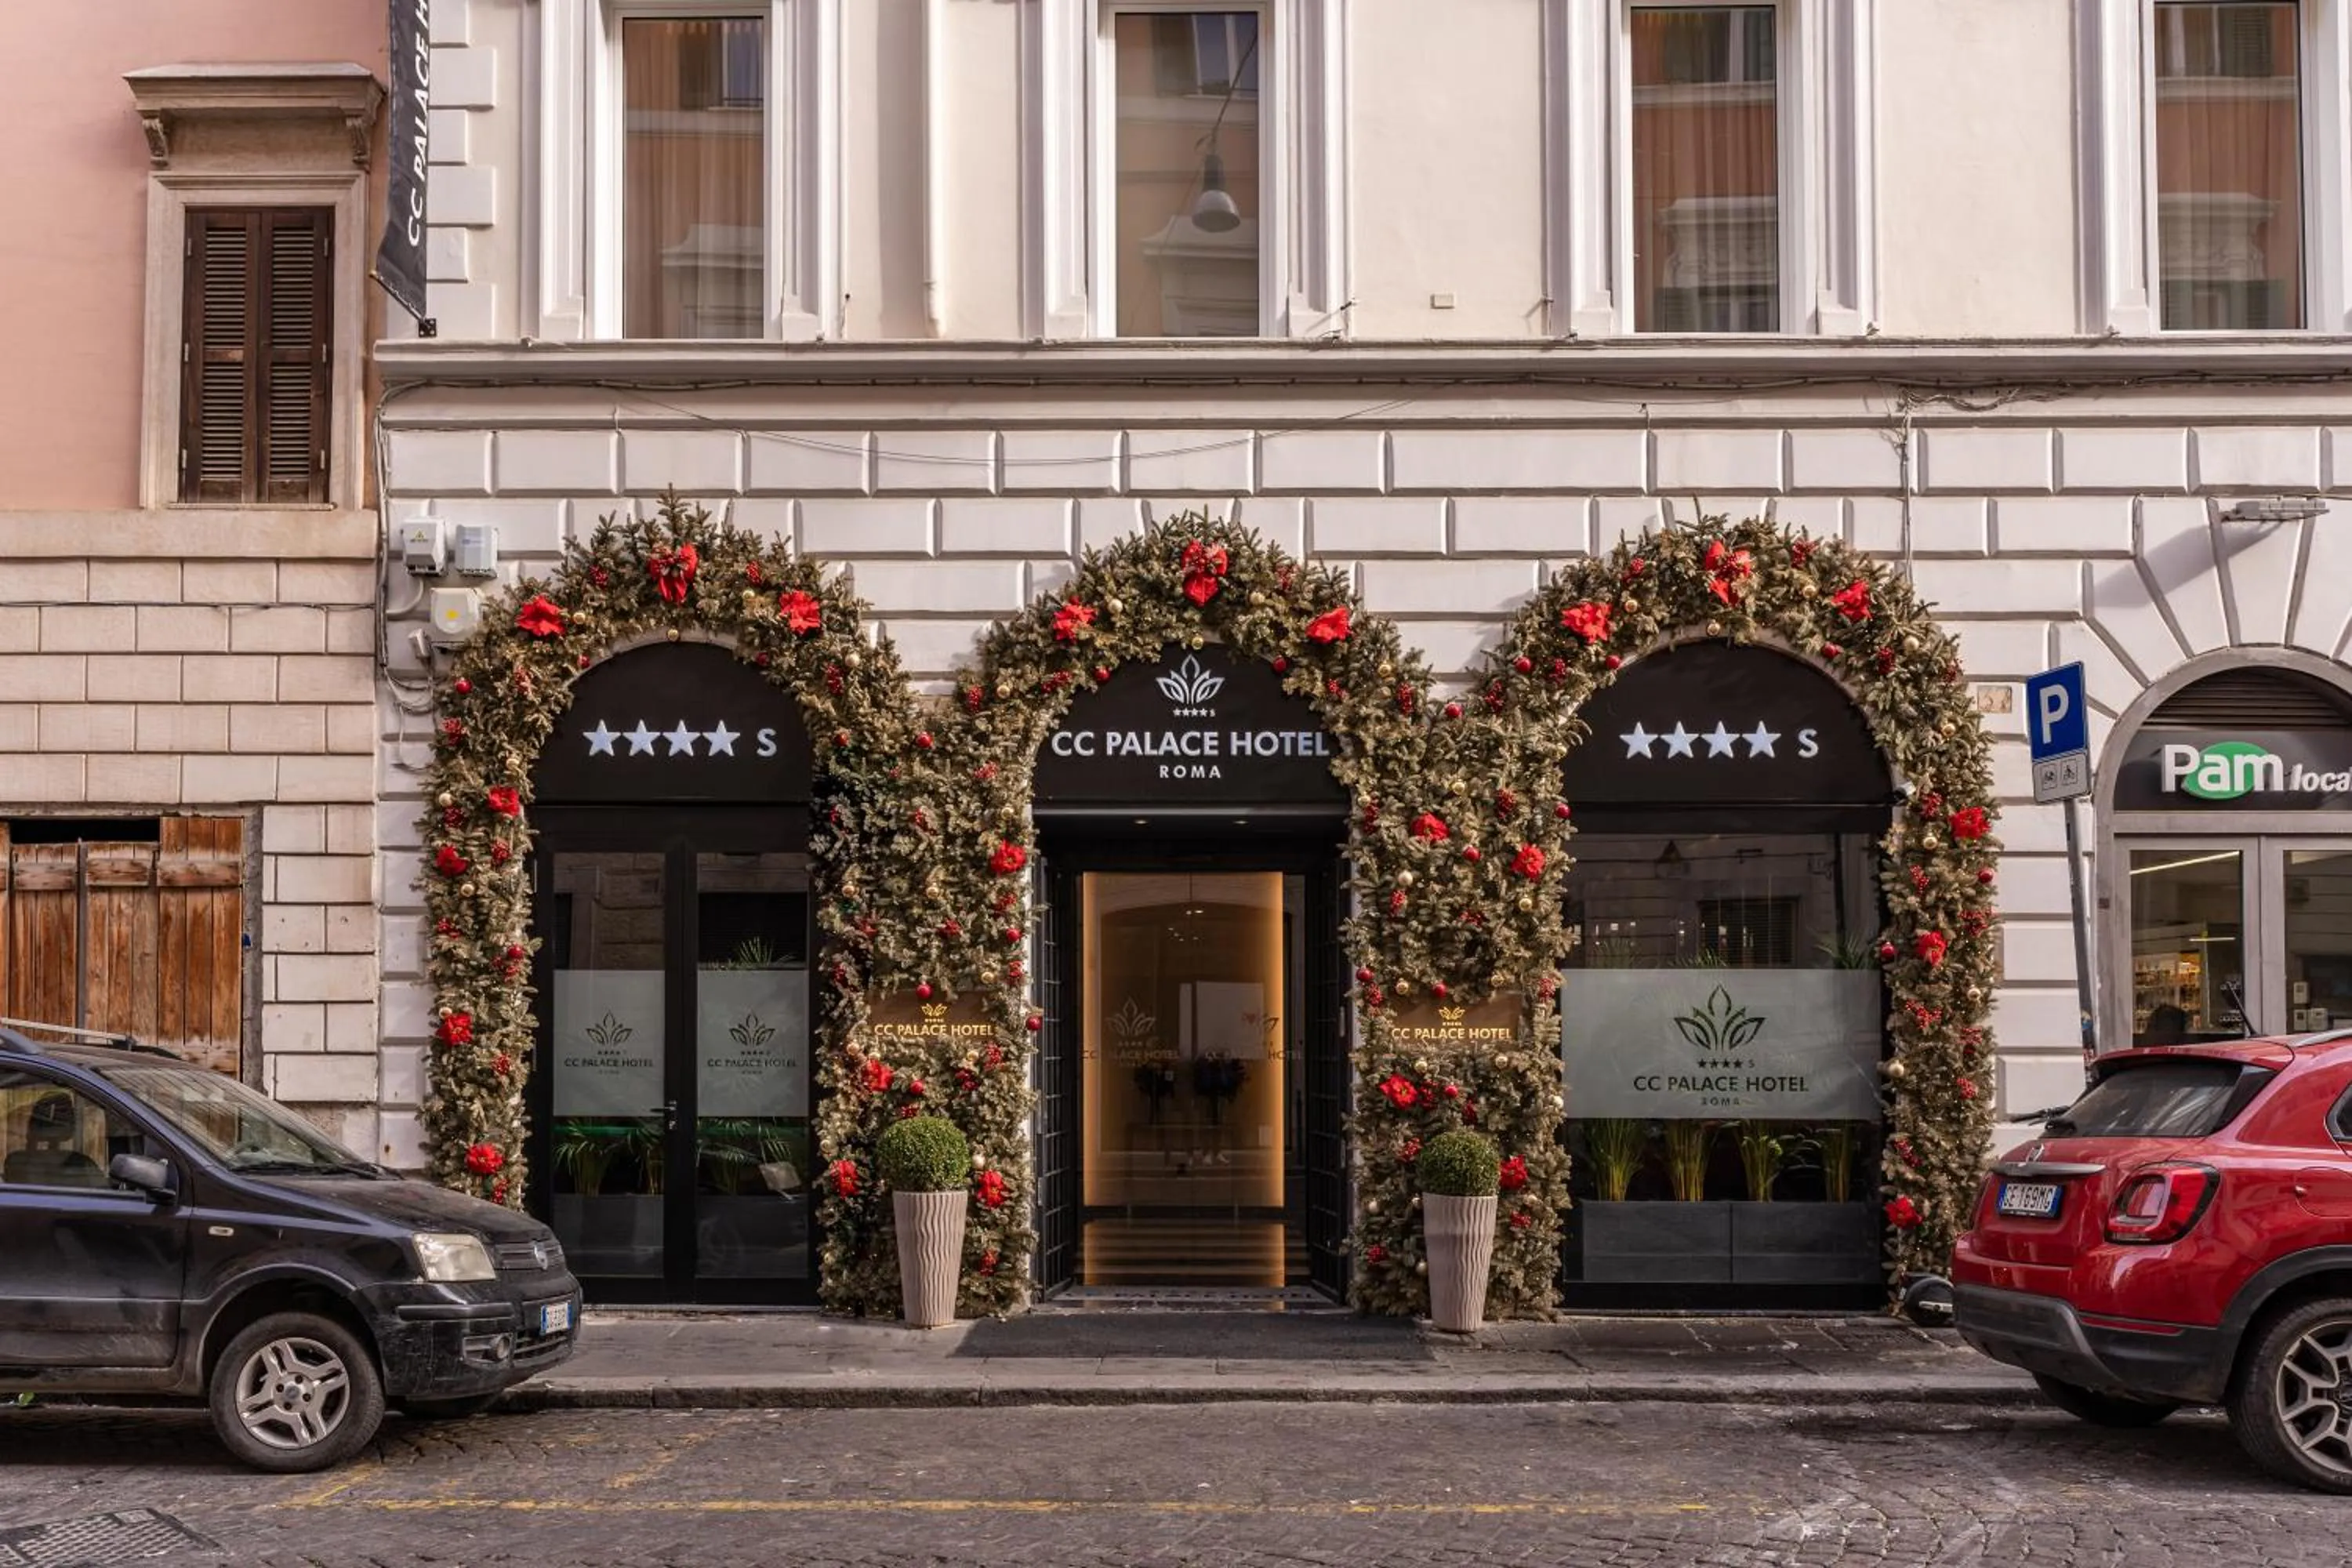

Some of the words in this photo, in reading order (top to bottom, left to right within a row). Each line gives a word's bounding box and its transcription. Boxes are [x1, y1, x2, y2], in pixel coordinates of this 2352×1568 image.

[413, 31, 429, 181] PALACE
[408, 188, 423, 247] CC
[2039, 684, 2070, 744] P
[757, 728, 777, 757] S
[1051, 731, 1094, 757] CC
[1106, 731, 1219, 757] PALACE
[1230, 731, 1330, 757] HOTEL
[1798, 728, 1819, 758] S
[1160, 764, 1221, 779] ROMA
[2161, 744, 2284, 793] Pam
[2288, 763, 2352, 792] loca
[874, 1024, 894, 1036] CC
[898, 1024, 947, 1036] PALACE
[951, 1024, 994, 1036] HOTEL
[1392, 1028, 1410, 1039] CC
[1414, 1028, 1465, 1039] PALACE
[1468, 1028, 1512, 1039] HOTEL
[1633, 1076, 1661, 1091] CC
[1668, 1076, 1740, 1091] PALACE
[1746, 1076, 1809, 1092] HOTEL
